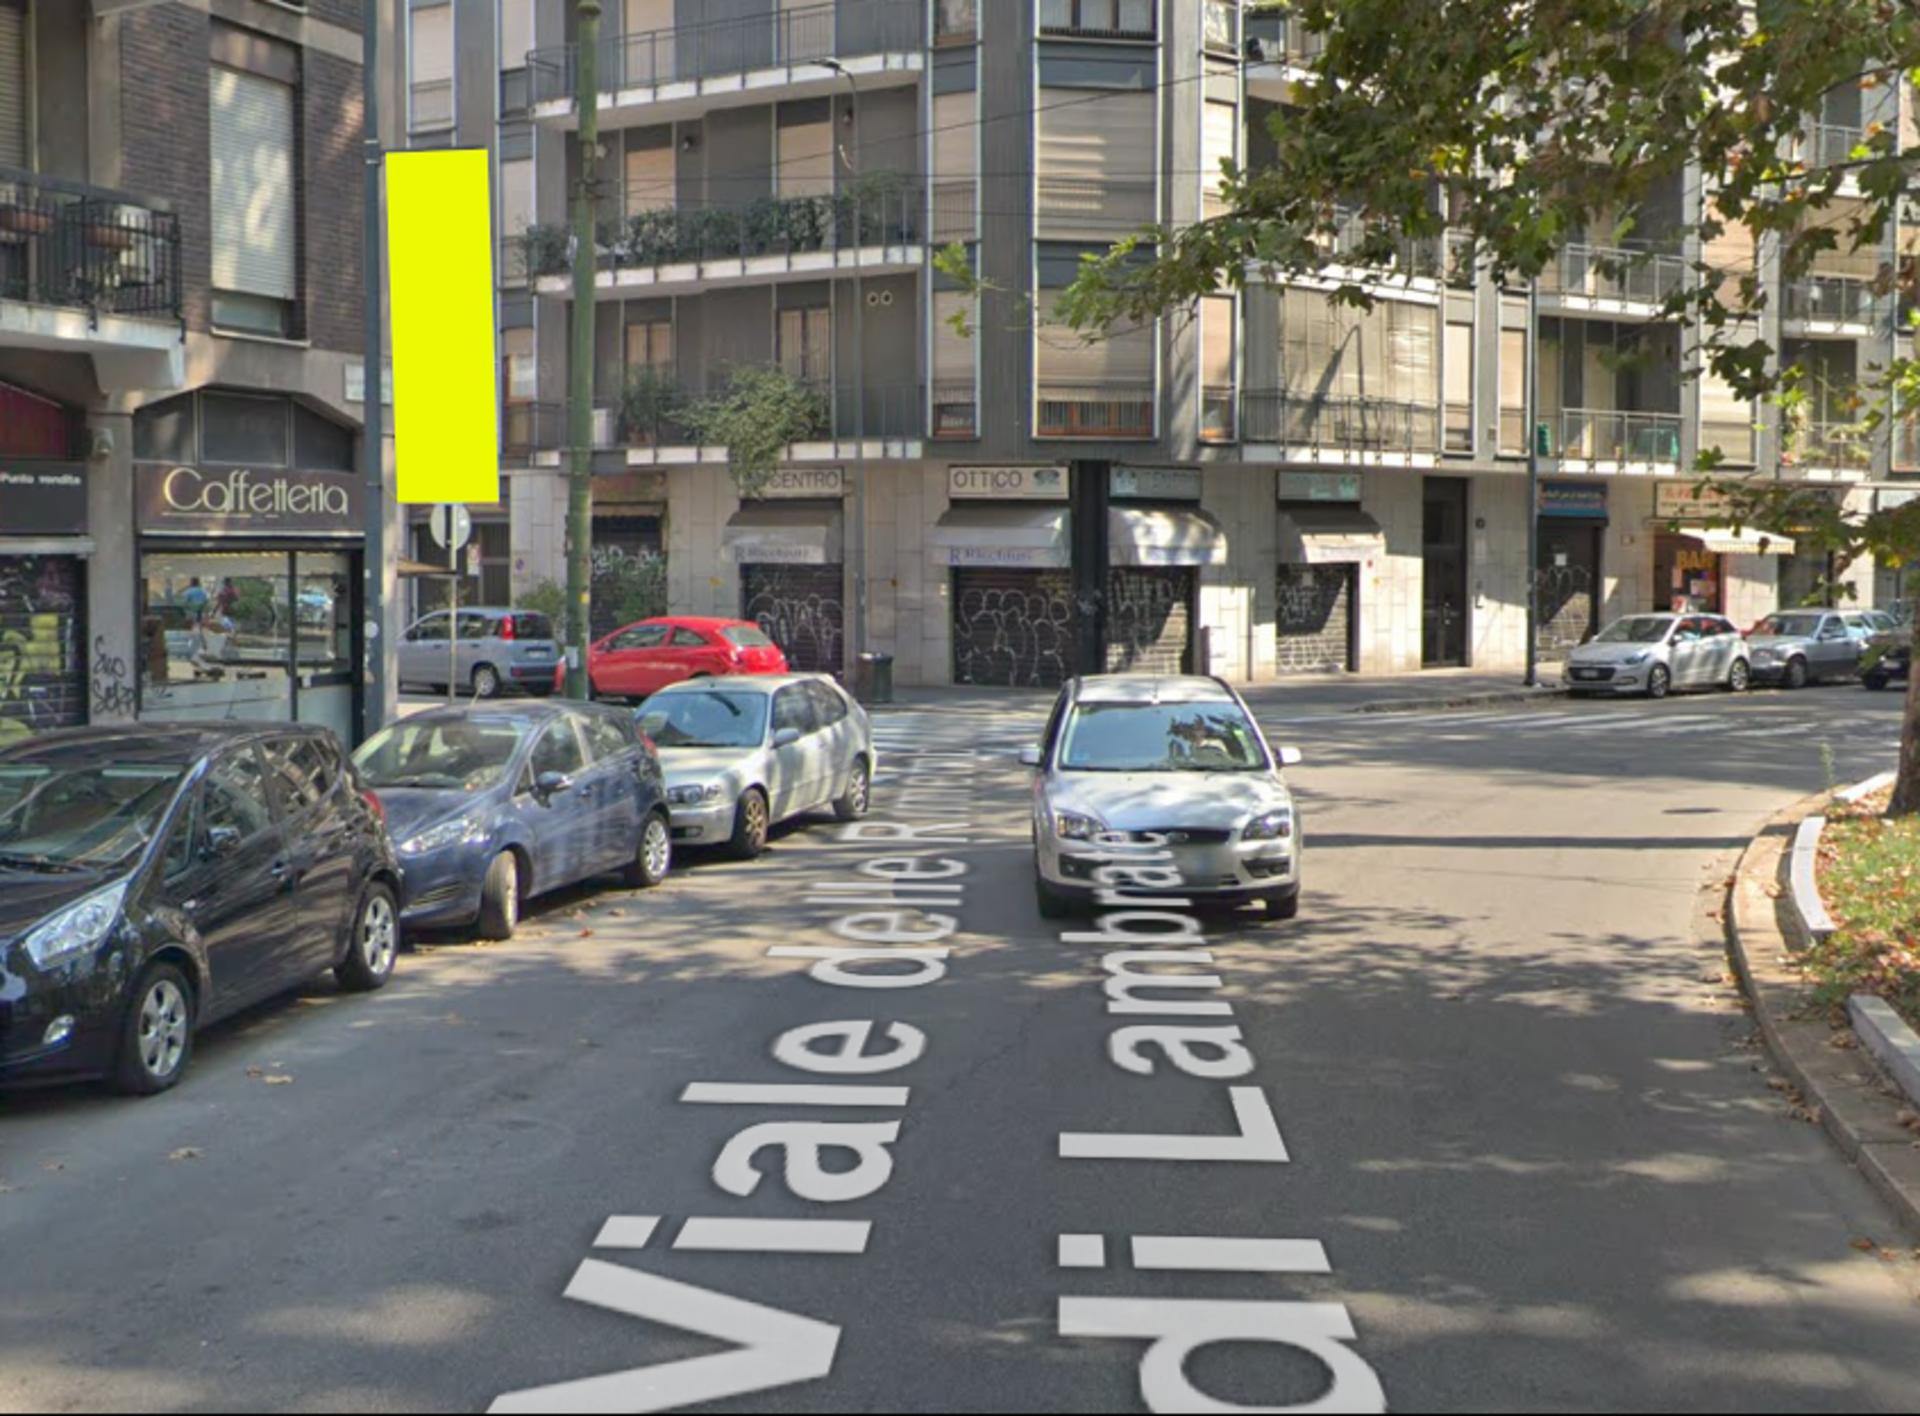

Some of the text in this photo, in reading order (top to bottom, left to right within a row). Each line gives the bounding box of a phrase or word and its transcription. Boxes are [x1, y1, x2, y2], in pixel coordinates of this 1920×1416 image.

[768, 471, 840, 490] CENTRO
[953, 470, 1024, 489] OTTICO
[163, 467, 348, 515] Caffetteria
